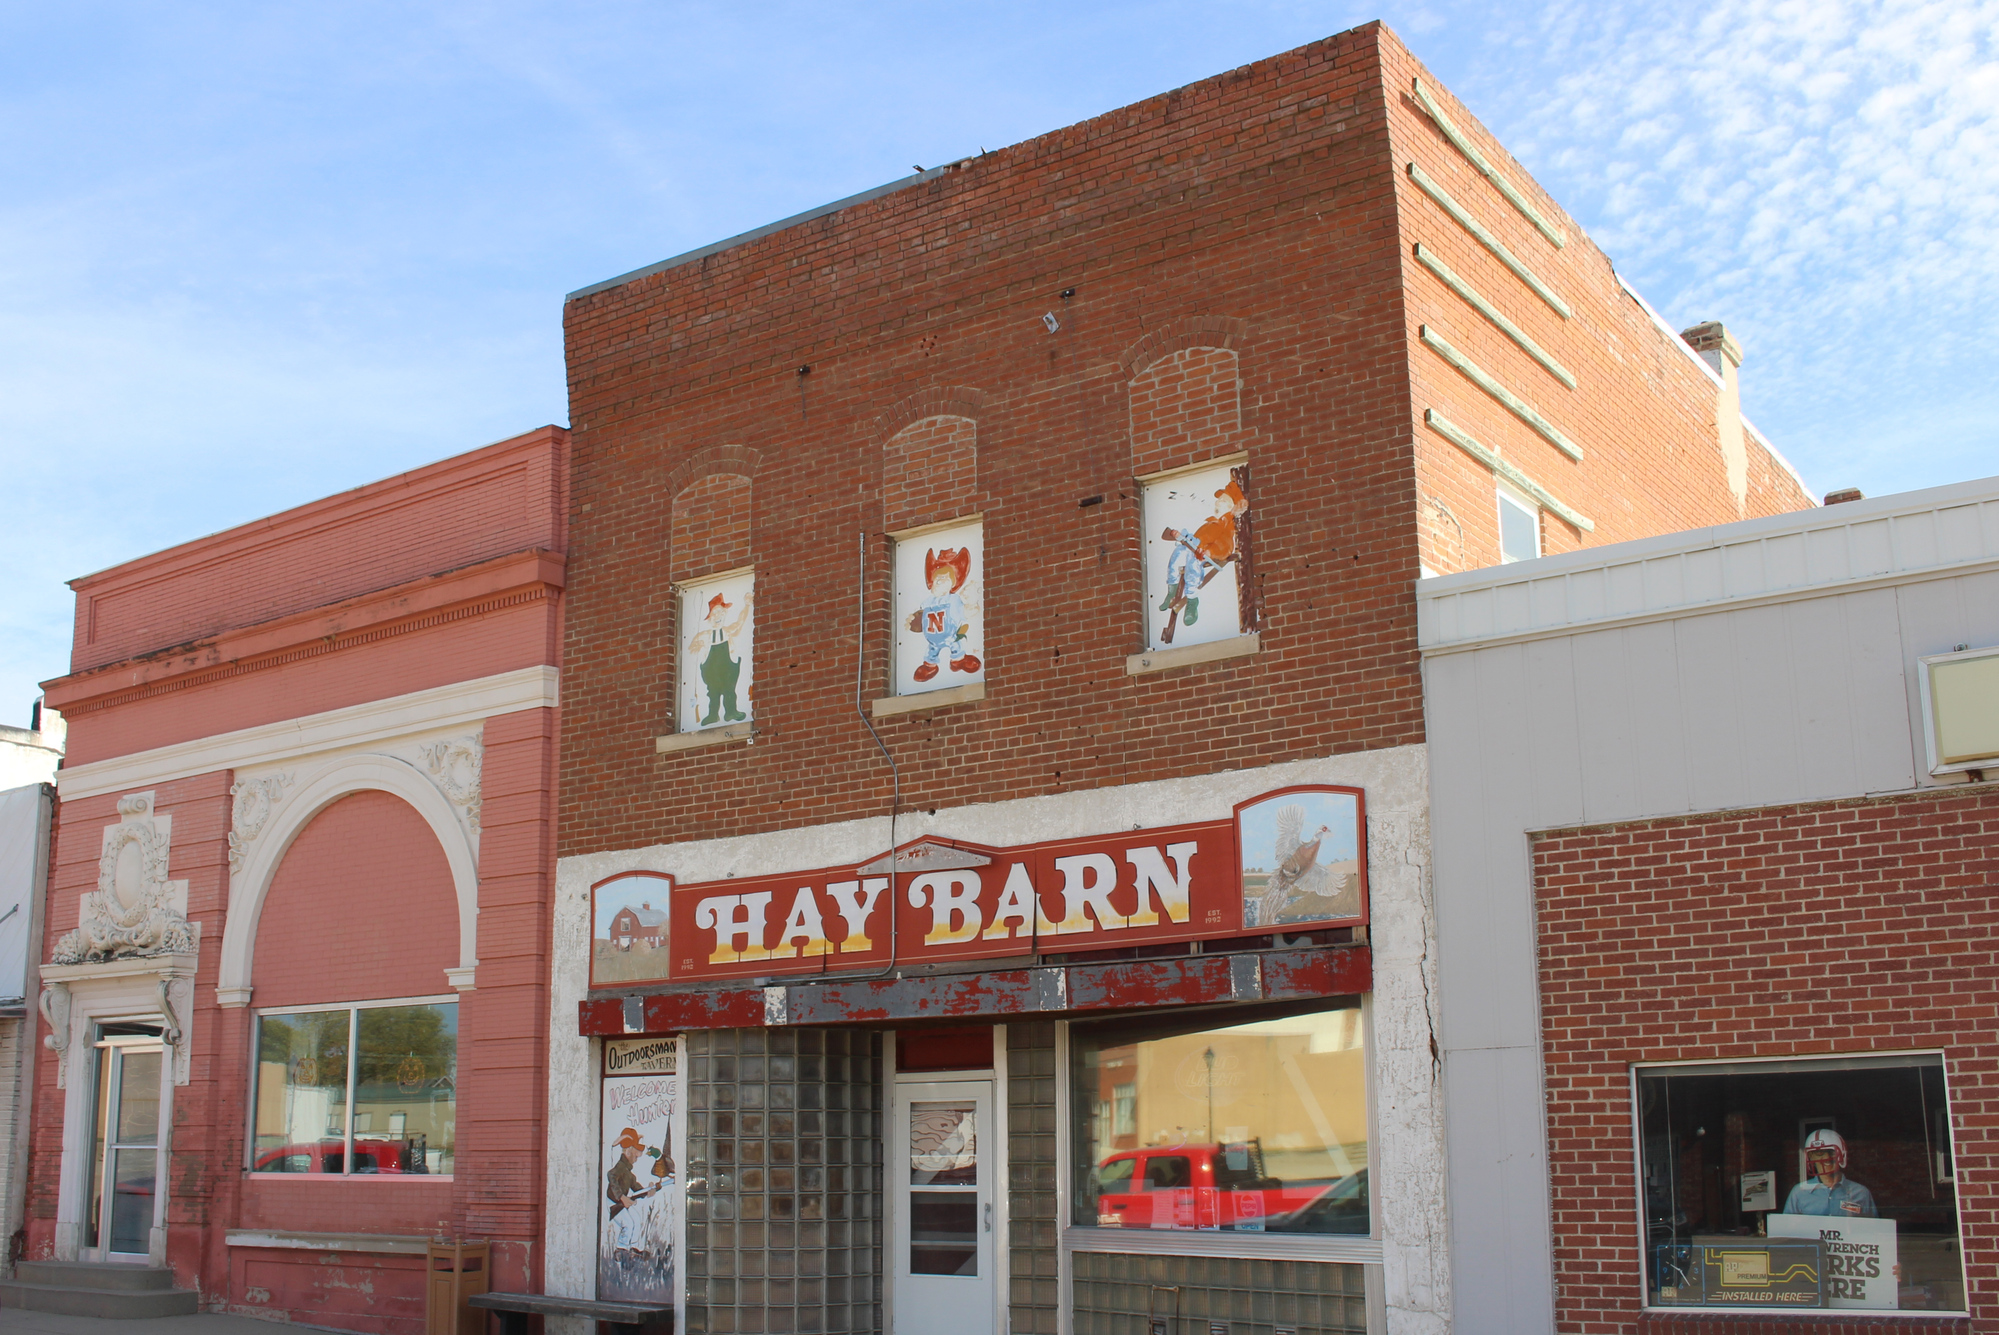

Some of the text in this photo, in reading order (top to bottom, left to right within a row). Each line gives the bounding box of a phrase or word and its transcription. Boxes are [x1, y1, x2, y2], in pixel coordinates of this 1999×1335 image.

[927, 611, 945, 633] N
[695, 841, 1198, 964] HAY BARN
[1205, 916, 1221, 924] 1992
[1185, 1071, 1246, 1087] LIGHT
[609, 1080, 677, 1110] WELCOME
[1241, 1222, 1259, 1230] OPEN
[1819, 1229, 1844, 1241] MR.
[1722, 1291, 1802, 1301] INSTALLED HERE
